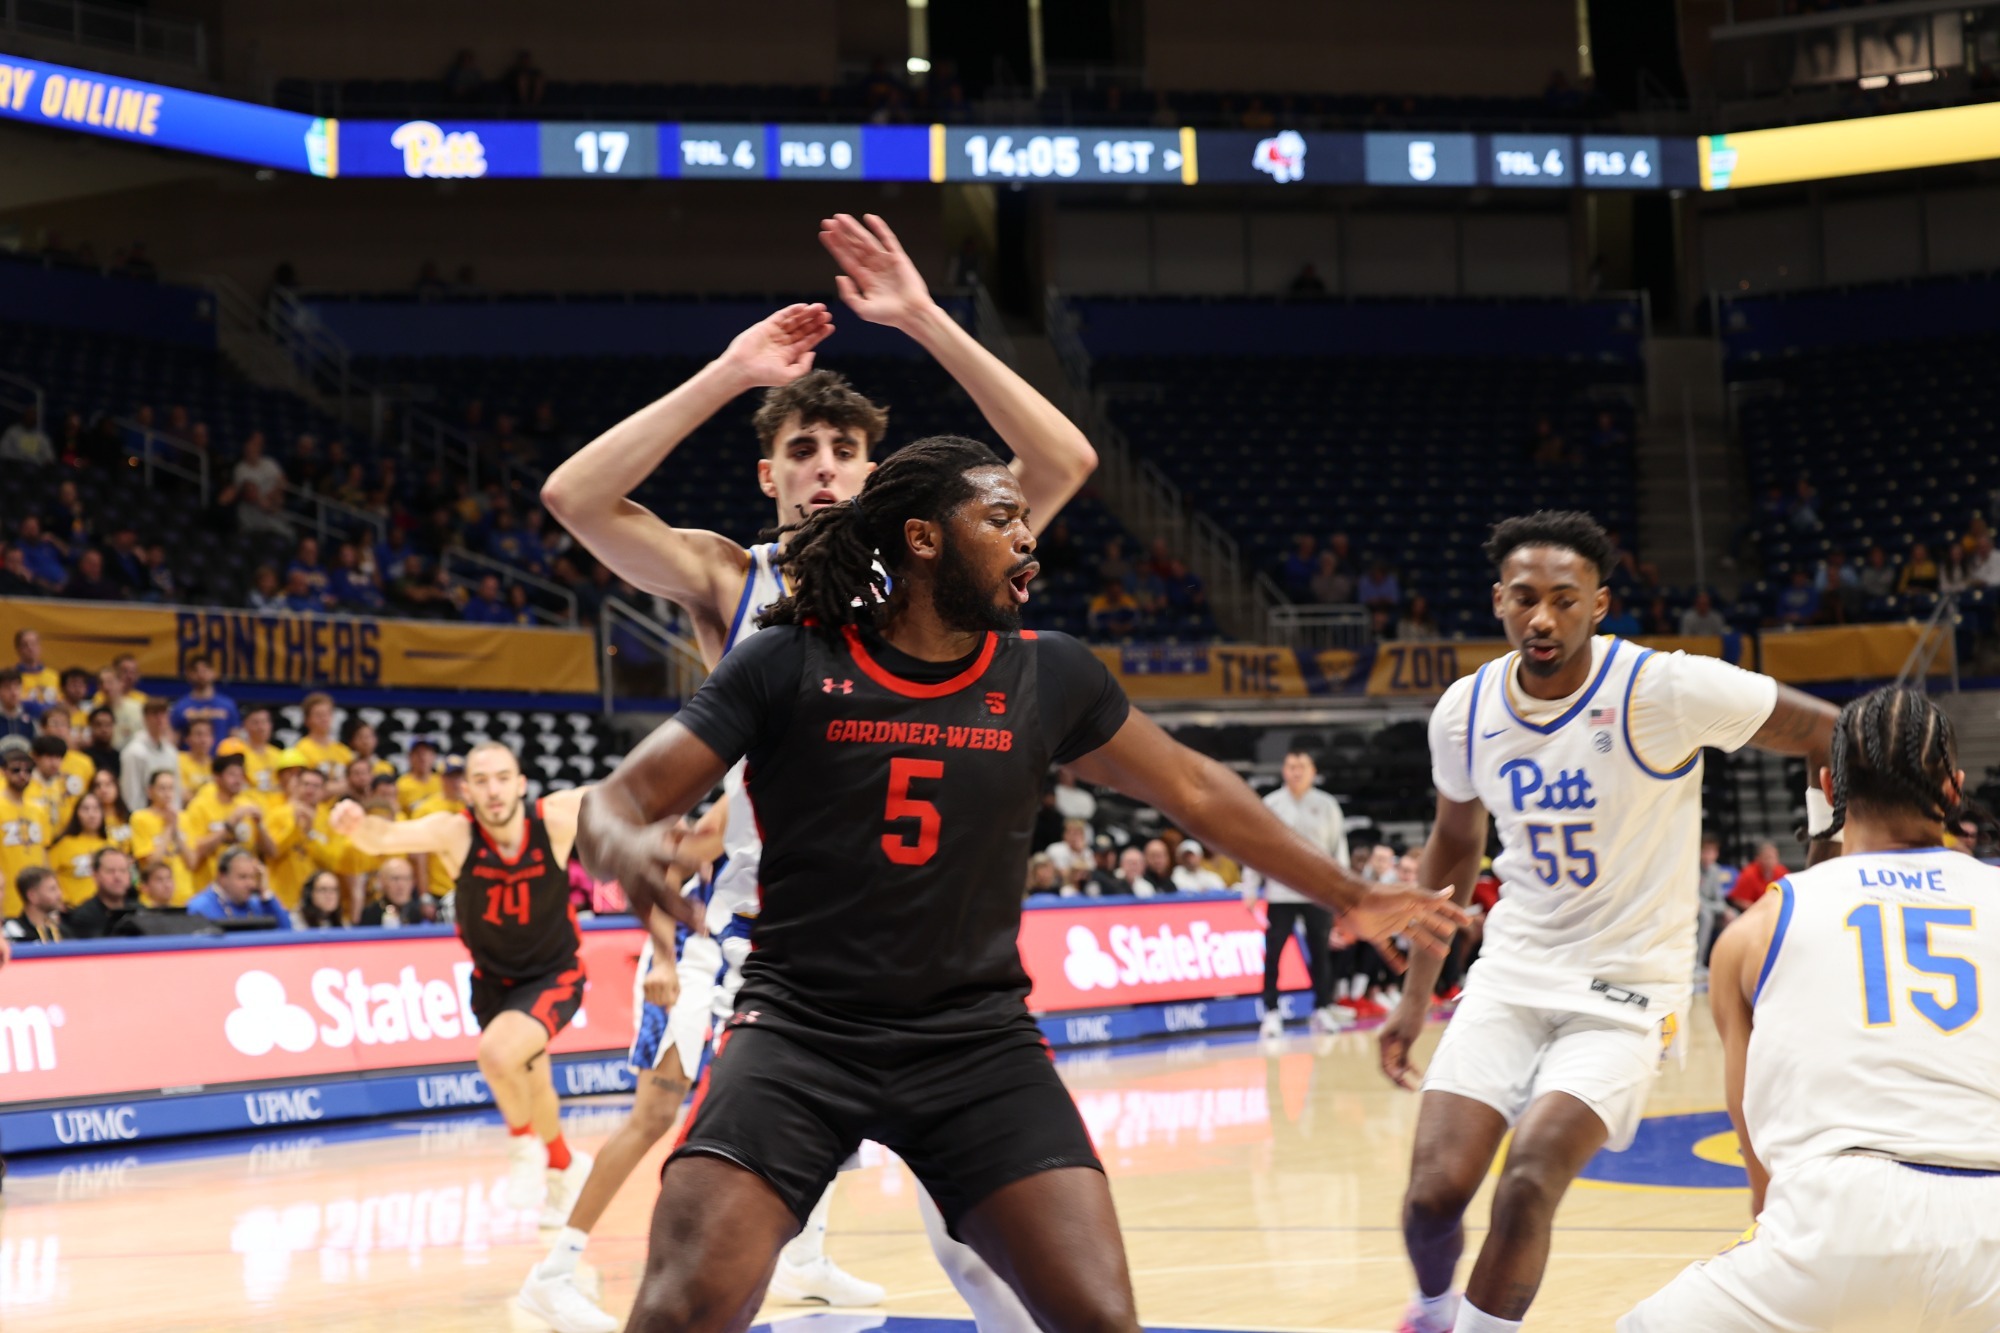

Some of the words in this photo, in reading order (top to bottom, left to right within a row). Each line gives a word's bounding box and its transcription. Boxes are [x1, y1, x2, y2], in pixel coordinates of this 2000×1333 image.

[40, 74, 164, 136] ONLINE
[390, 120, 488, 179] Pitt
[574, 130, 630, 173] 17
[732, 140, 756, 170] 4
[780, 141, 826, 168] FLS
[965, 135, 1081, 177] 14:05
[1093, 140, 1155, 174] 1ST
[1408, 141, 1436, 181] 5
[1542, 149, 1565, 177] 4
[1584, 151, 1626, 176] FLS
[1630, 150, 1652, 178] 4
[176, 612, 382, 685] PANTHERS
[1217, 652, 1282, 693] THE
[1389, 648, 1460, 690] ZOO
[826, 719, 1013, 752] GARDNER-WEBB
[1499, 758, 1597, 812] Pitt
[881, 757, 944, 866] 5
[1526, 821, 1598, 888] 55
[1858, 867, 1947, 892] LOWE
[482, 880, 530, 926] 14
[1843, 901, 1983, 1037] 15
[416, 1071, 488, 1108] UPMC
[565, 1057, 632, 1095] UPMC
[51, 1105, 140, 1144] UPMC
[244, 1087, 324, 1125] UPMC
